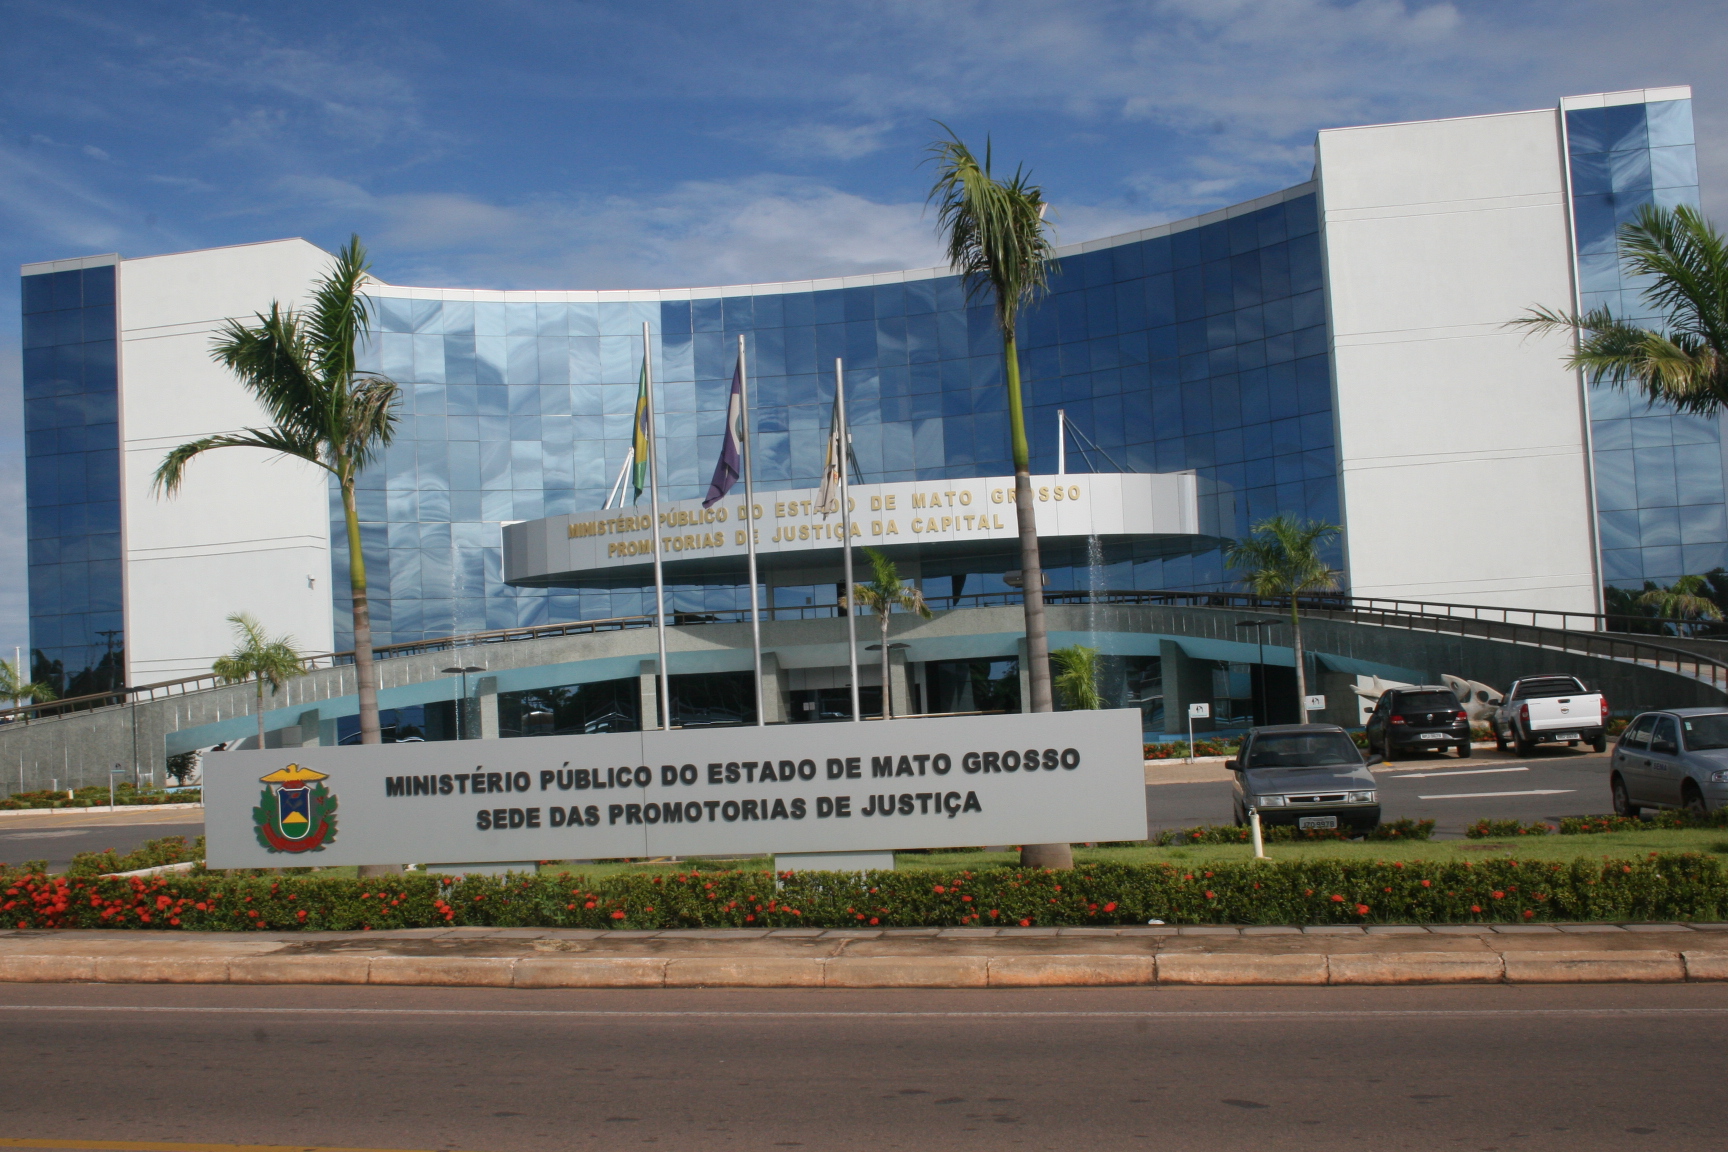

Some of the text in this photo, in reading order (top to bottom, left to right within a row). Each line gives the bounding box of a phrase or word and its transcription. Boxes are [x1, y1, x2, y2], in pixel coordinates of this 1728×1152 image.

[568, 514, 651, 538] MINISTÉRIO
[659, 507, 728, 528] PÚBLICO
[737, 504, 763, 520] DO
[871, 494, 896, 511] DE
[912, 490, 973, 509] MATO
[991, 485, 1081, 504] GRSSO
[608, 531, 725, 558] PROMTORIAS
[772, 521, 862, 543] JUSTIÇA
[872, 519, 899, 536] DA
[912, 513, 1005, 533] CAPITAL
[385, 748, 1081, 798] MINISTÉRIO PÚBLICO DO ESTADO DE MATO GROSSO
[476, 790, 982, 831] SEDE DAS PROMOTORIAS DE JUSTIÇA
